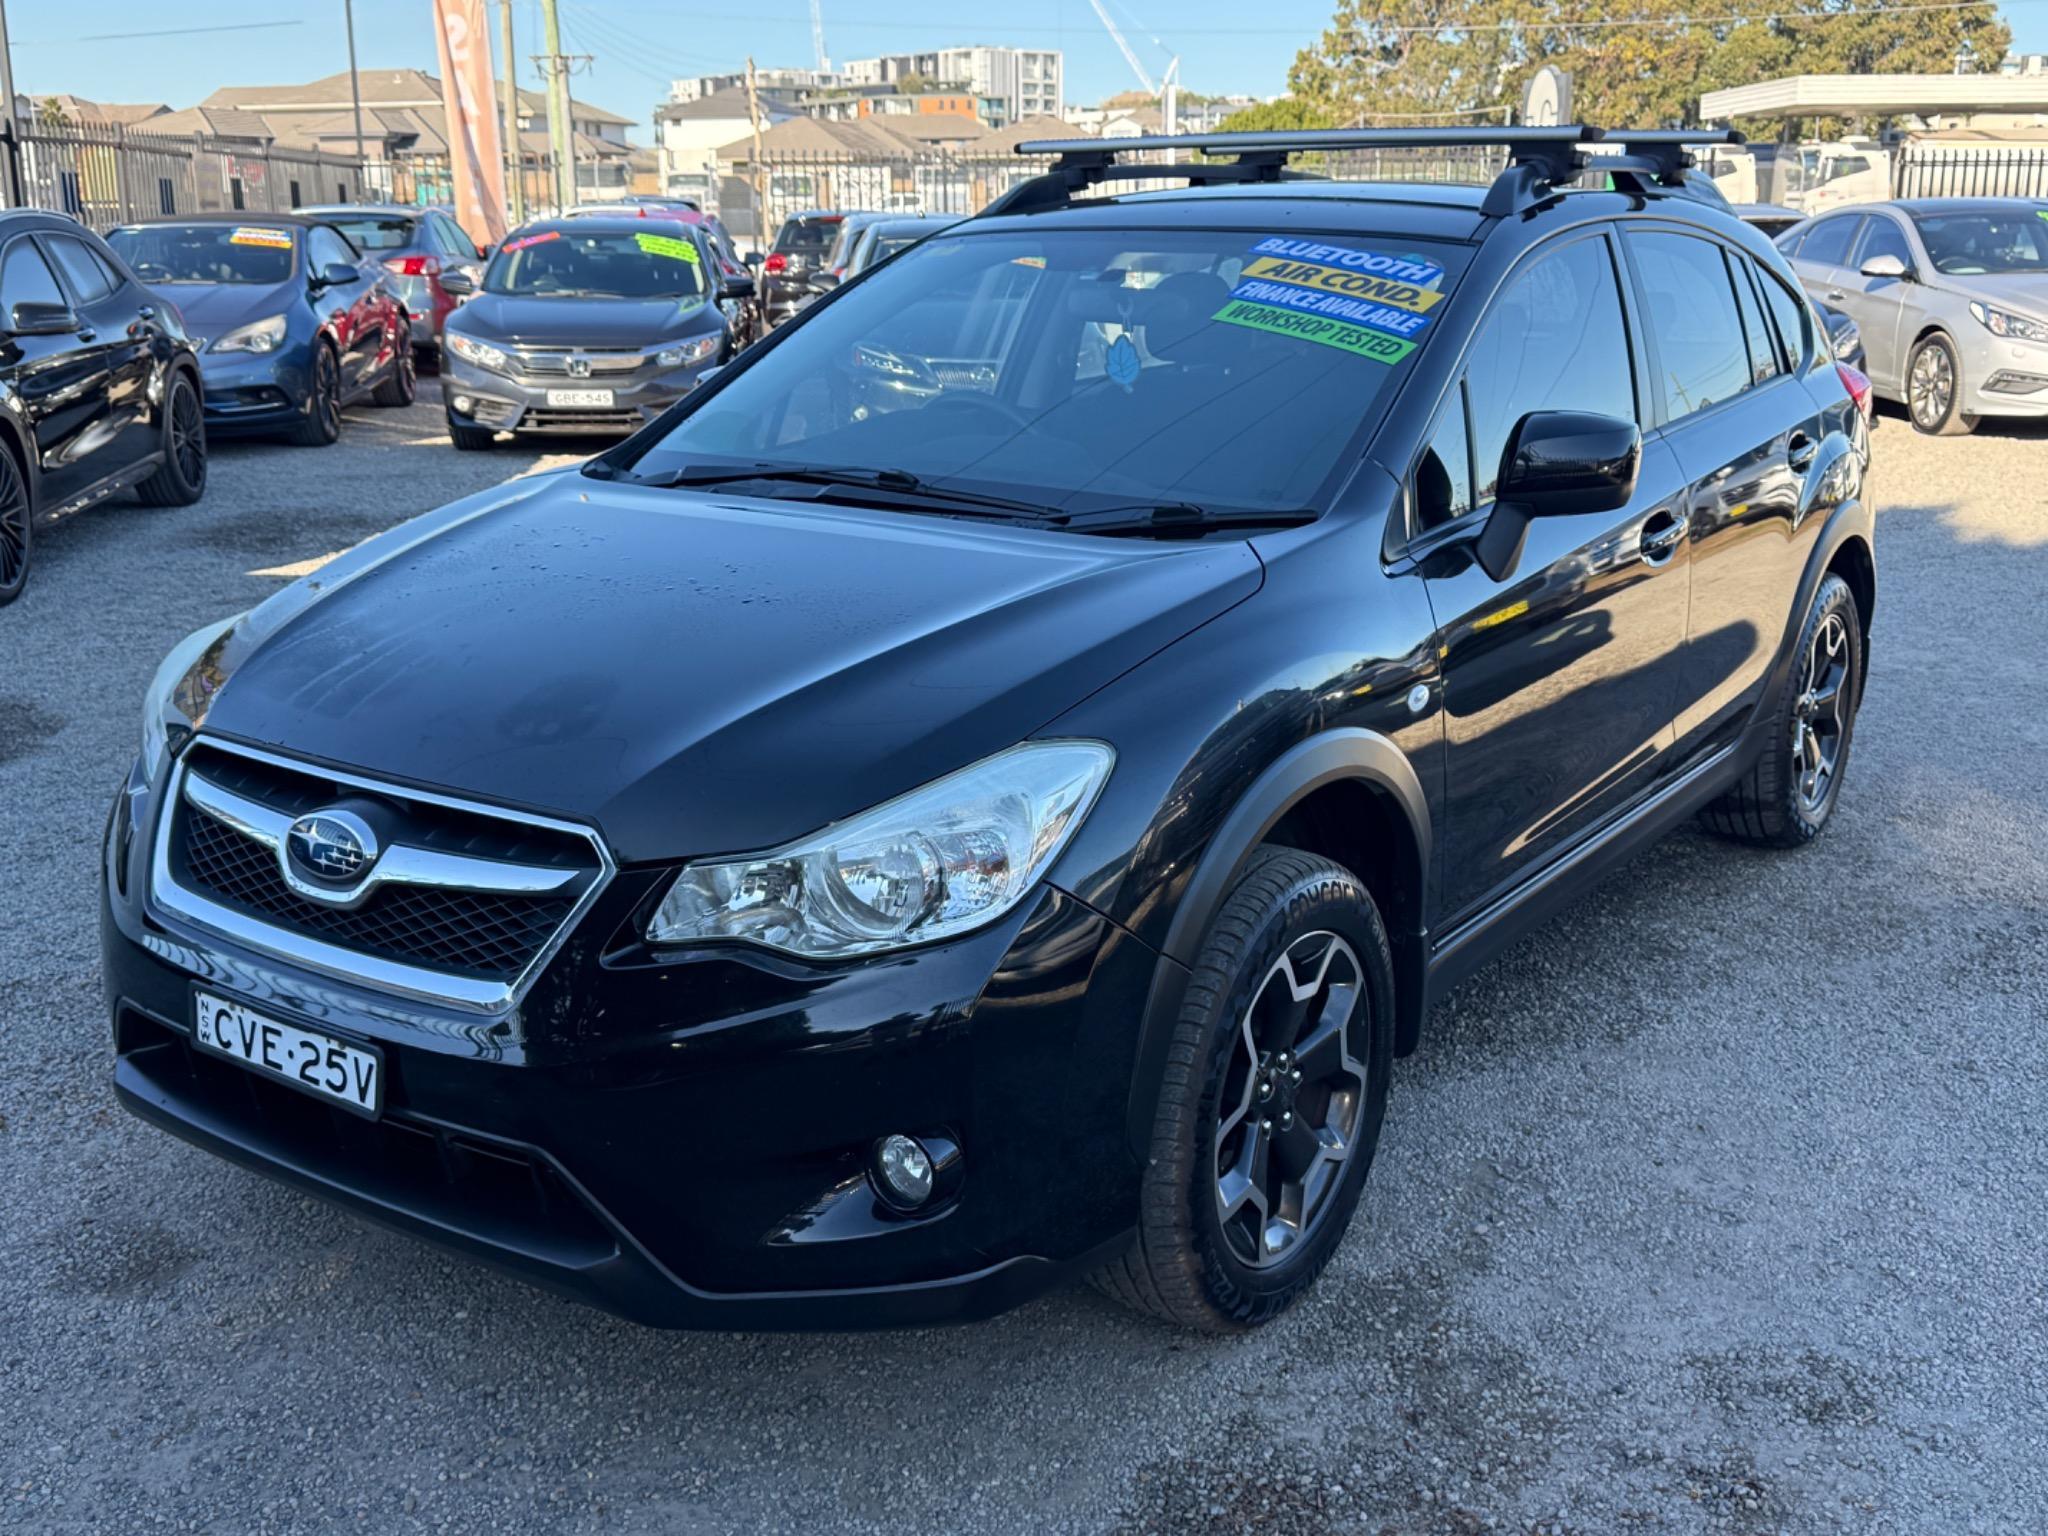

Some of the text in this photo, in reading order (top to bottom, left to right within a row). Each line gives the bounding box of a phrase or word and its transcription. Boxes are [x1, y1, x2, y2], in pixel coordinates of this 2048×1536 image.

[1256, 238, 1435, 281] BLUETOOTH
[1235, 281, 1425, 333] FINANCE AVAILABLE
[1258, 262, 1421, 306] AIR COND.
[1227, 303, 1403, 357] WORKSHOP TESTED
